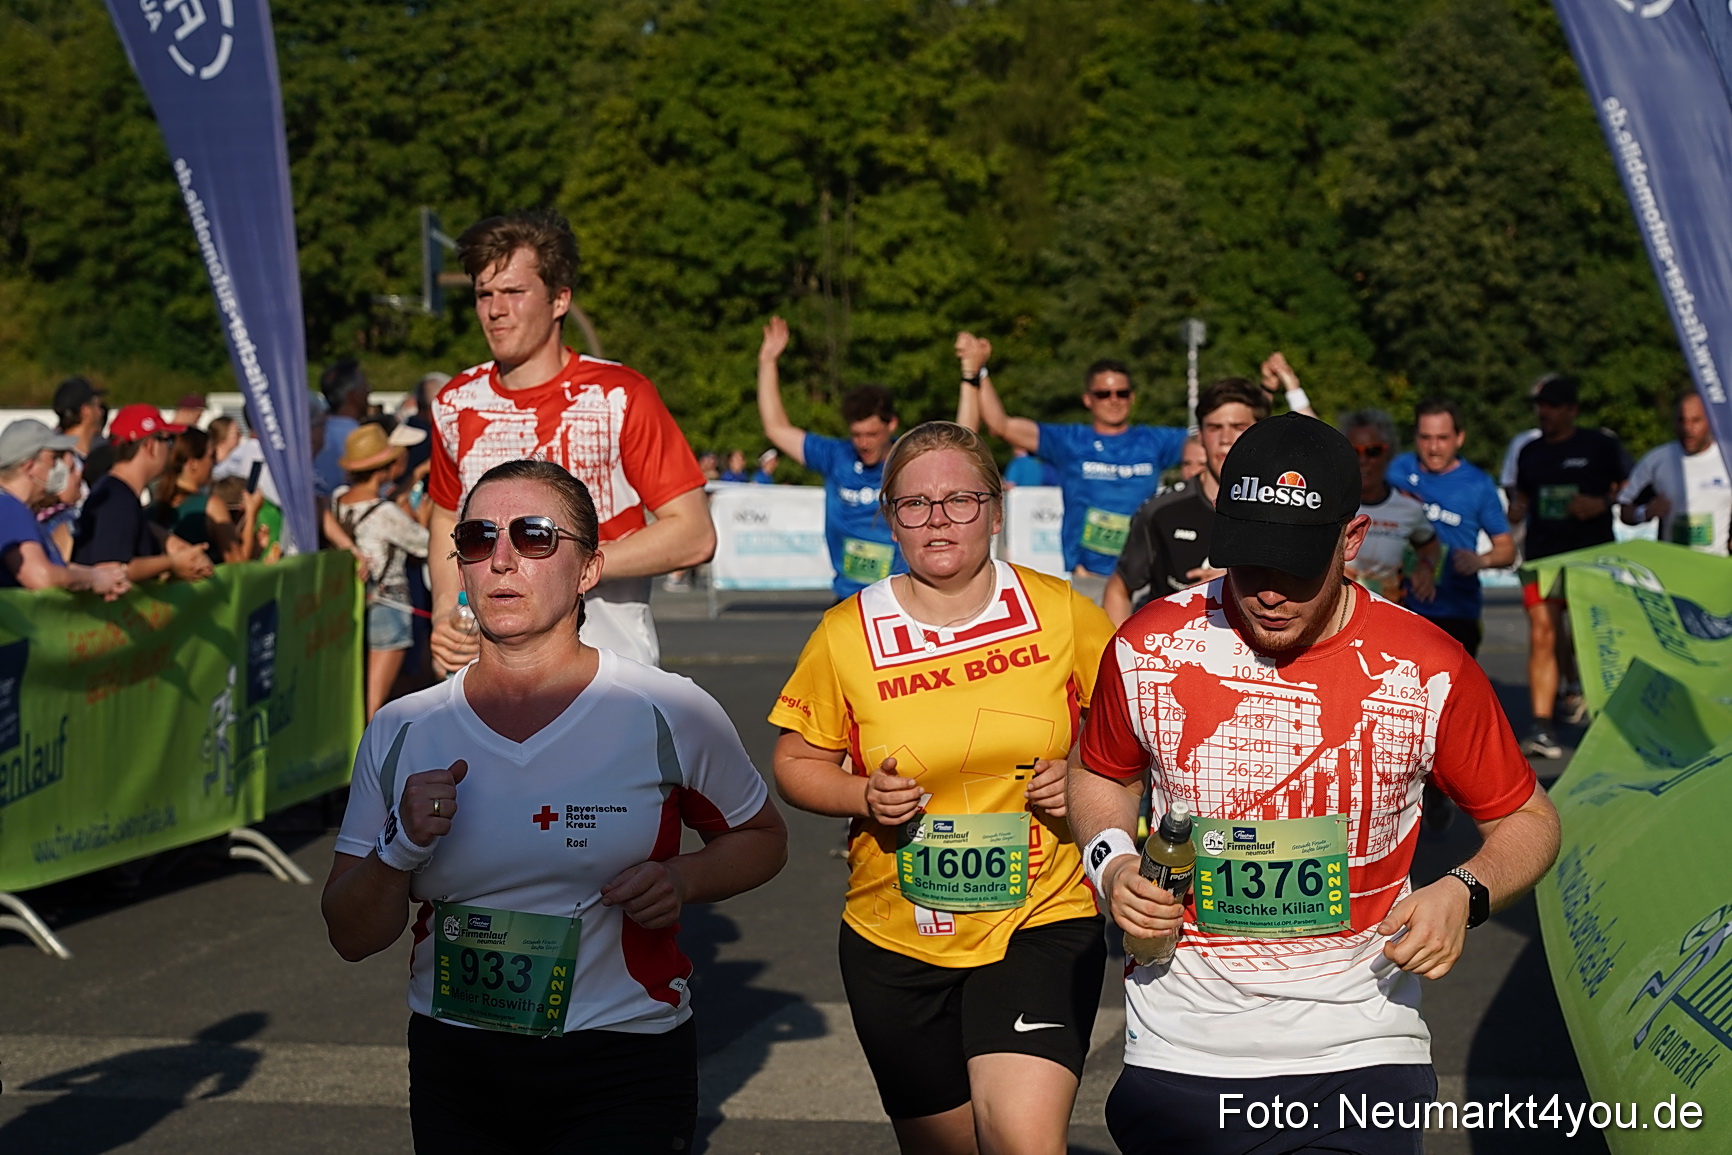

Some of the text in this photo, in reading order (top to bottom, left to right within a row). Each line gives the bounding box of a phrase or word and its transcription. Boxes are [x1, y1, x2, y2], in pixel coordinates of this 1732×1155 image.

[1230, 476, 1322, 509] ellesse
[1145, 634, 1206, 653] 9.0276
[877, 643, 1050, 701] MAX BÖGL
[1232, 665, 1276, 682] 10.54
[1379, 683, 1426, 703] 91.62%
[1228, 737, 1274, 754] 52.01
[1226, 761, 1274, 779] 26.22
[566, 804, 628, 814] Bayerisches
[566, 812, 596, 821] Rotes
[566, 820, 597, 829] Kreuz
[927, 831, 970, 840] Firmenlauf
[1227, 841, 1276, 851] Firmenlauf
[903, 851, 914, 884] RUN
[917, 846, 1007, 879] 1606
[1009, 850, 1022, 896] 2022
[914, 877, 1007, 893] Schmid Sandra
[1201, 870, 1214, 910] RUN
[1217, 859, 1324, 899] 1376
[1327, 862, 1343, 916] 2022
[1217, 900, 1325, 916] Raschke Kilian
[460, 928, 508, 940] Firmenlauf
[440, 955, 450, 996] RUN
[461, 948, 533, 994] 933
[451, 986, 480, 1004] Meier
[482, 993, 545, 1013] Roswitha
[547, 965, 567, 1019] 2022
[1648, 1024, 1721, 1090] neumarkt
